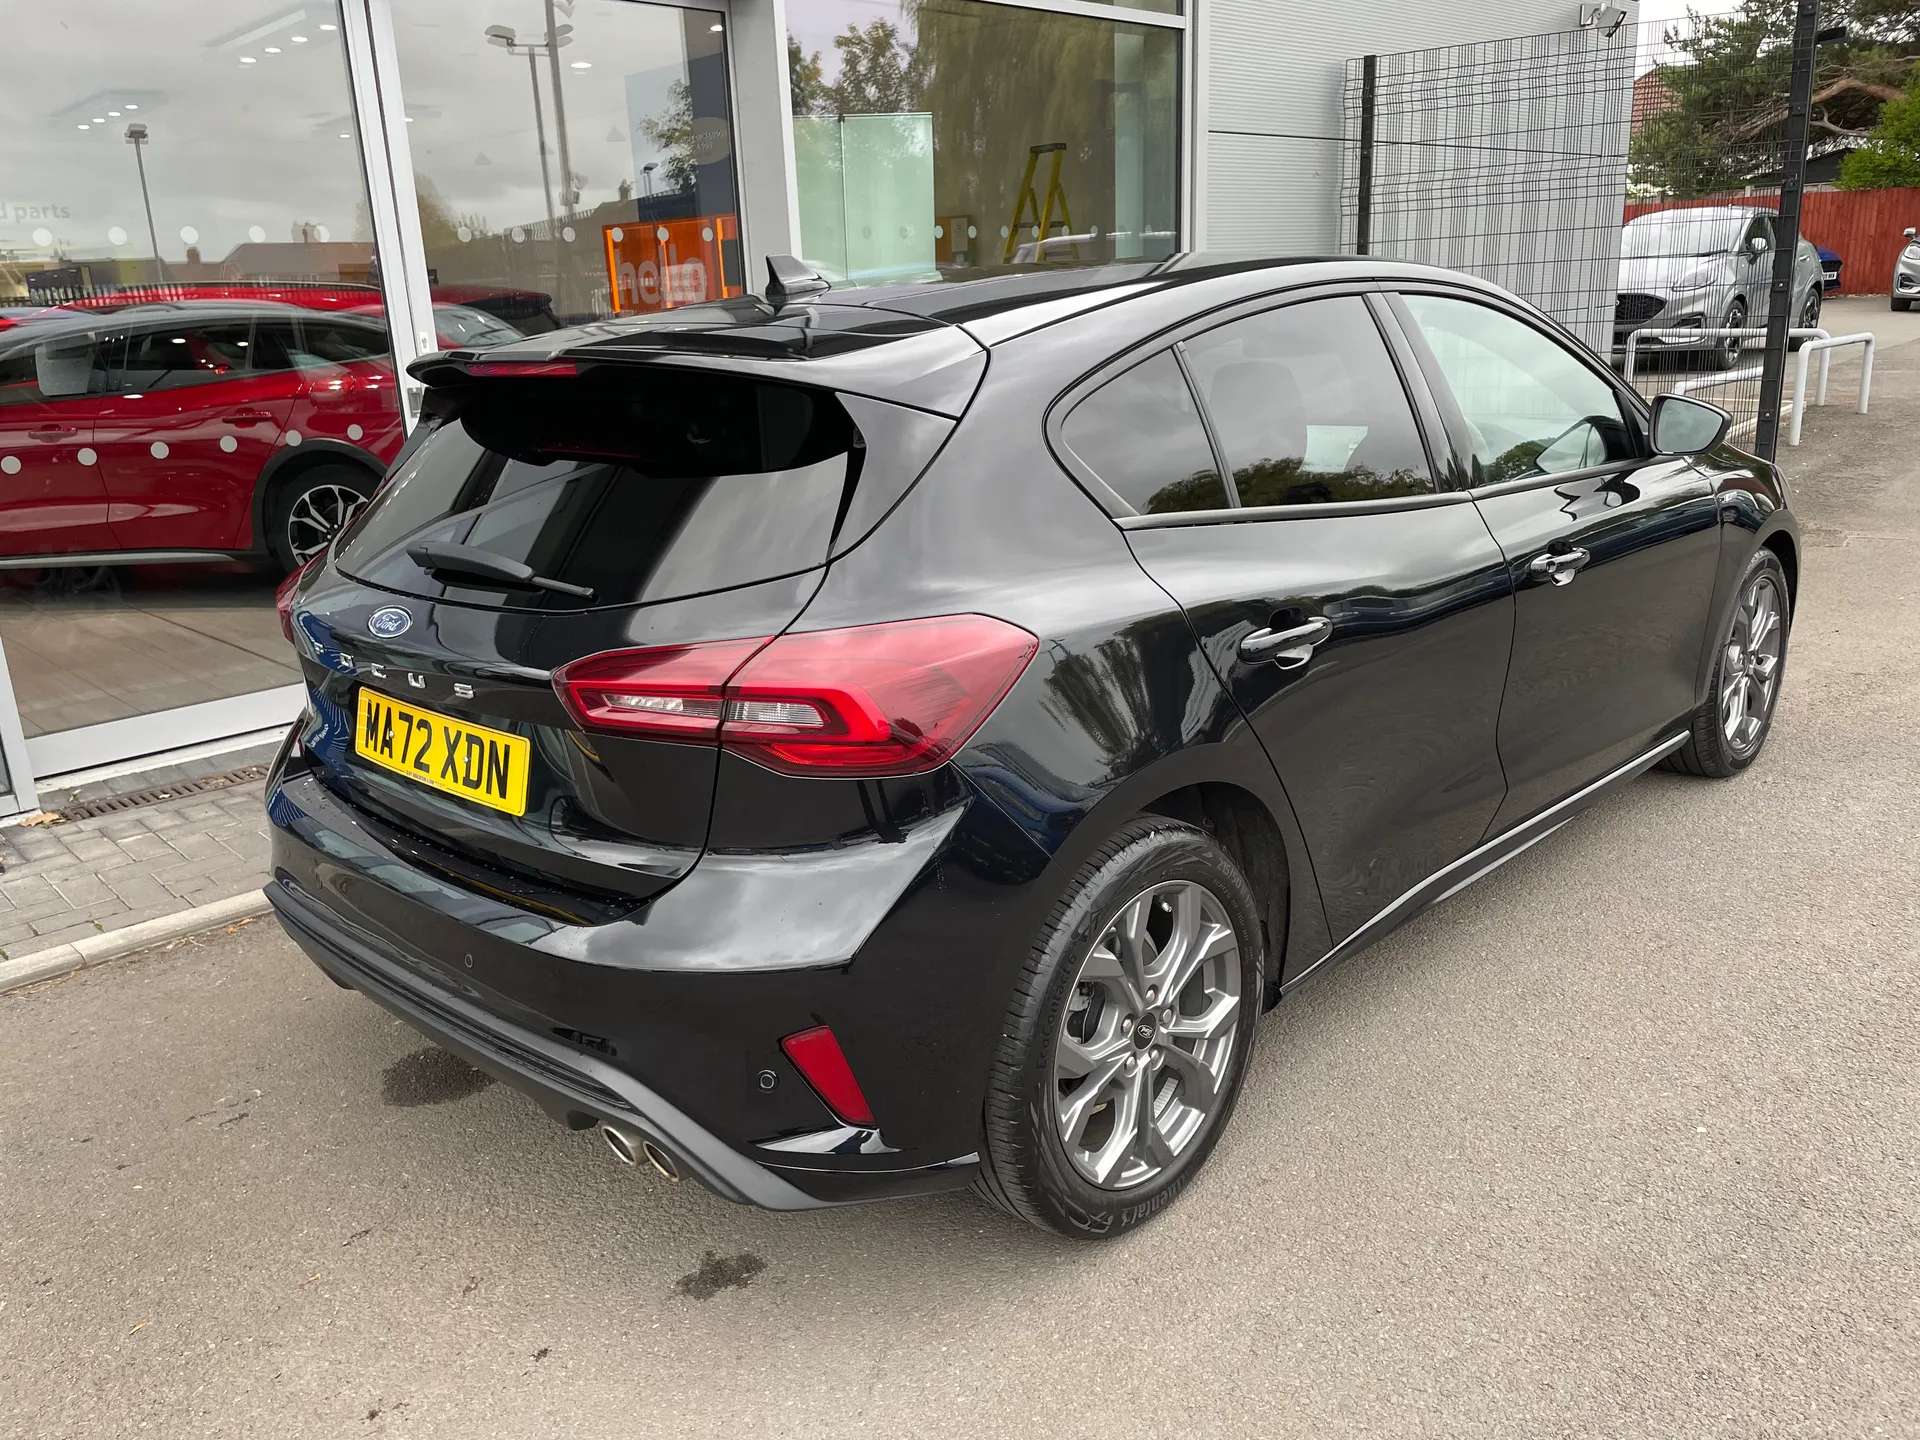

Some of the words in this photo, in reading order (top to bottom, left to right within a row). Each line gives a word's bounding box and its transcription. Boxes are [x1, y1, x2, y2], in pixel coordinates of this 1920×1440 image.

[15, 204, 71, 224] parts
[613, 243, 707, 305] hello
[313, 640, 475, 700] FOCUS
[365, 699, 432, 774] MA72
[440, 726, 511, 800] XDN
